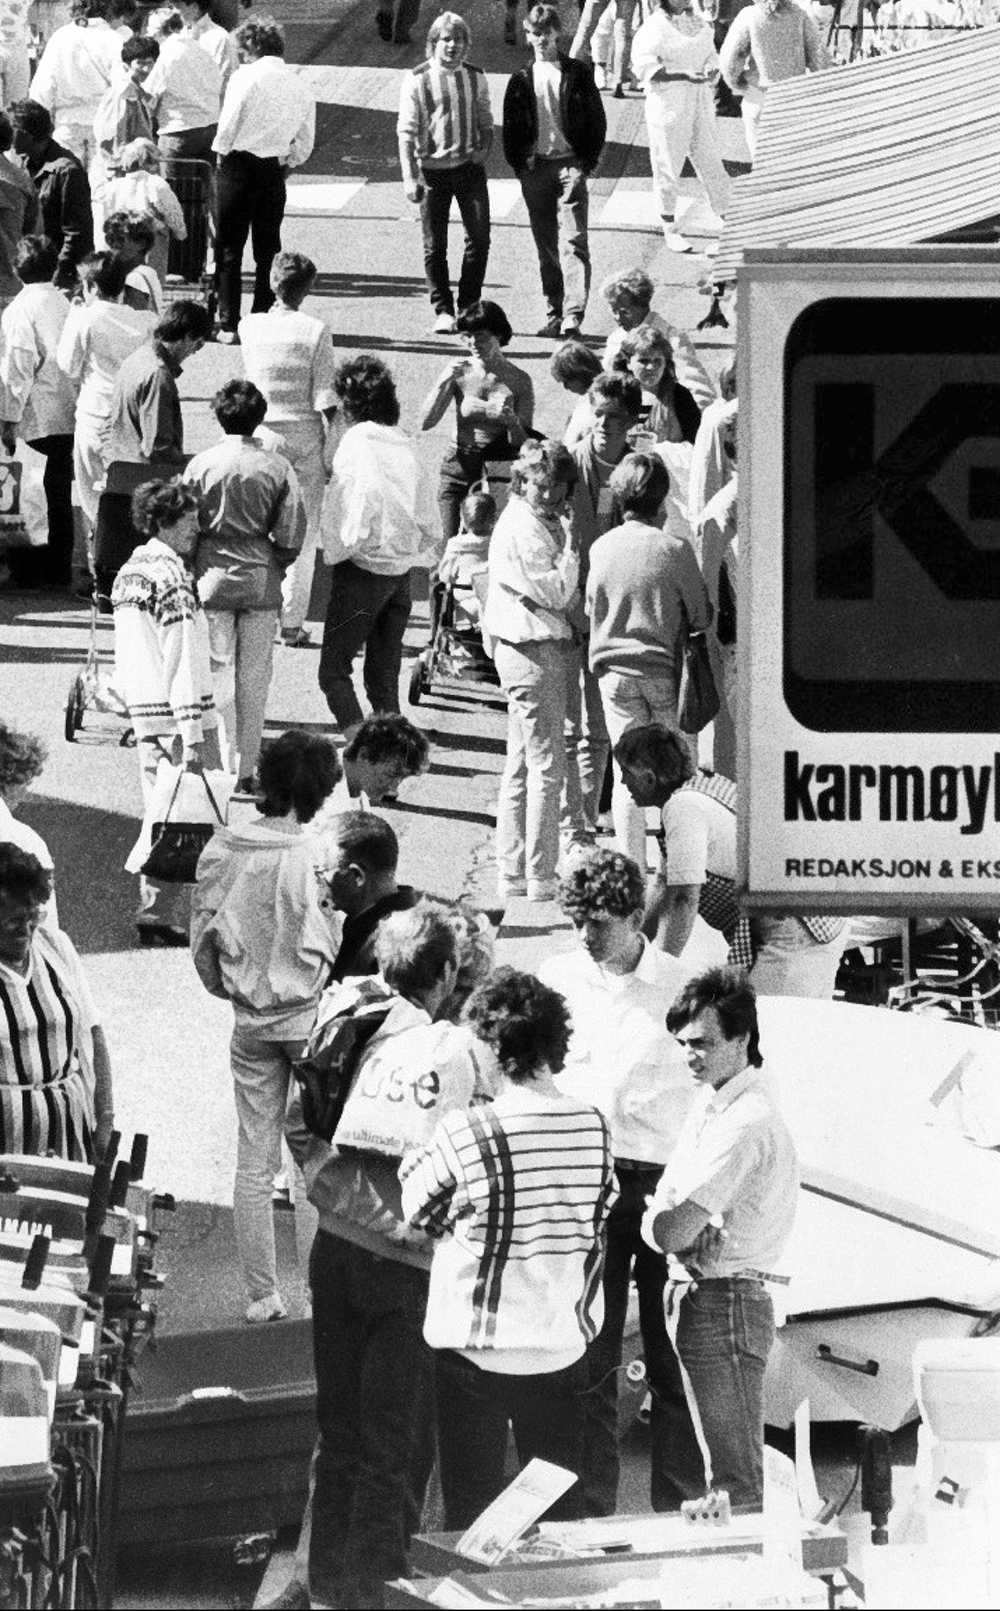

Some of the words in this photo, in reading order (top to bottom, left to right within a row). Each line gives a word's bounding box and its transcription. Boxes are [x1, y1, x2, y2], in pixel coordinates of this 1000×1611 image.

[784, 750, 1000, 835] karmøy
[784, 858, 932, 878] REDAKSJON
[938, 859, 954, 878] &
[352, 1129, 401, 1149] ultimate
